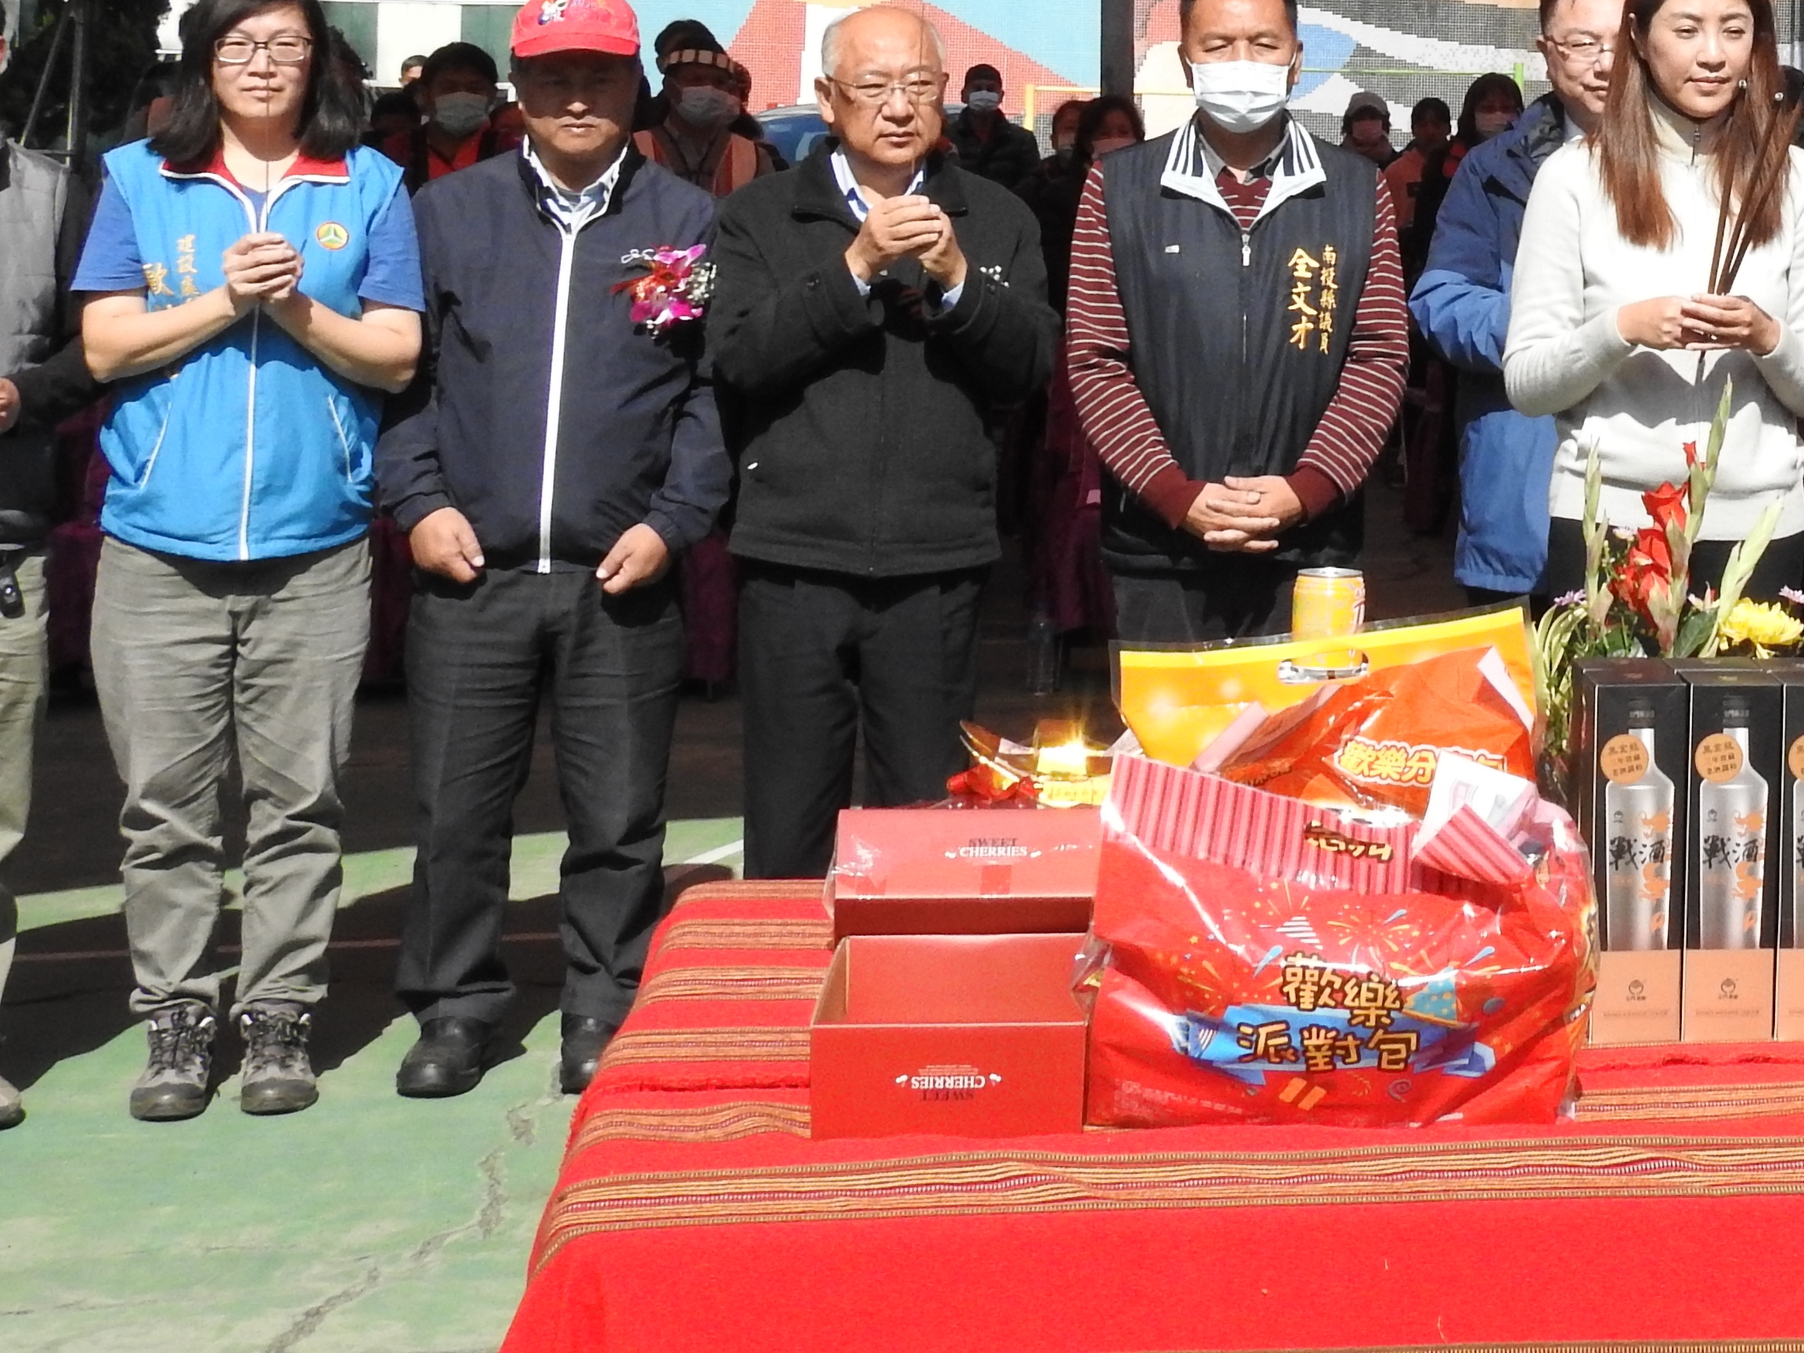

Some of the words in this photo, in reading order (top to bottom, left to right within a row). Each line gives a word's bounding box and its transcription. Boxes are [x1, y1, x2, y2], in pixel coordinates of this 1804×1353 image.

[1288, 248, 1320, 349] 全文才
[1319, 244, 1338, 355] 南投縣議員
[959, 846, 1028, 858] CHERRIES
[968, 837, 1018, 847] SWEET
[1281, 952, 1404, 1028] 歡樂
[1237, 1020, 1420, 1072] 派對包
[910, 1075, 986, 1089] CHERRIES
